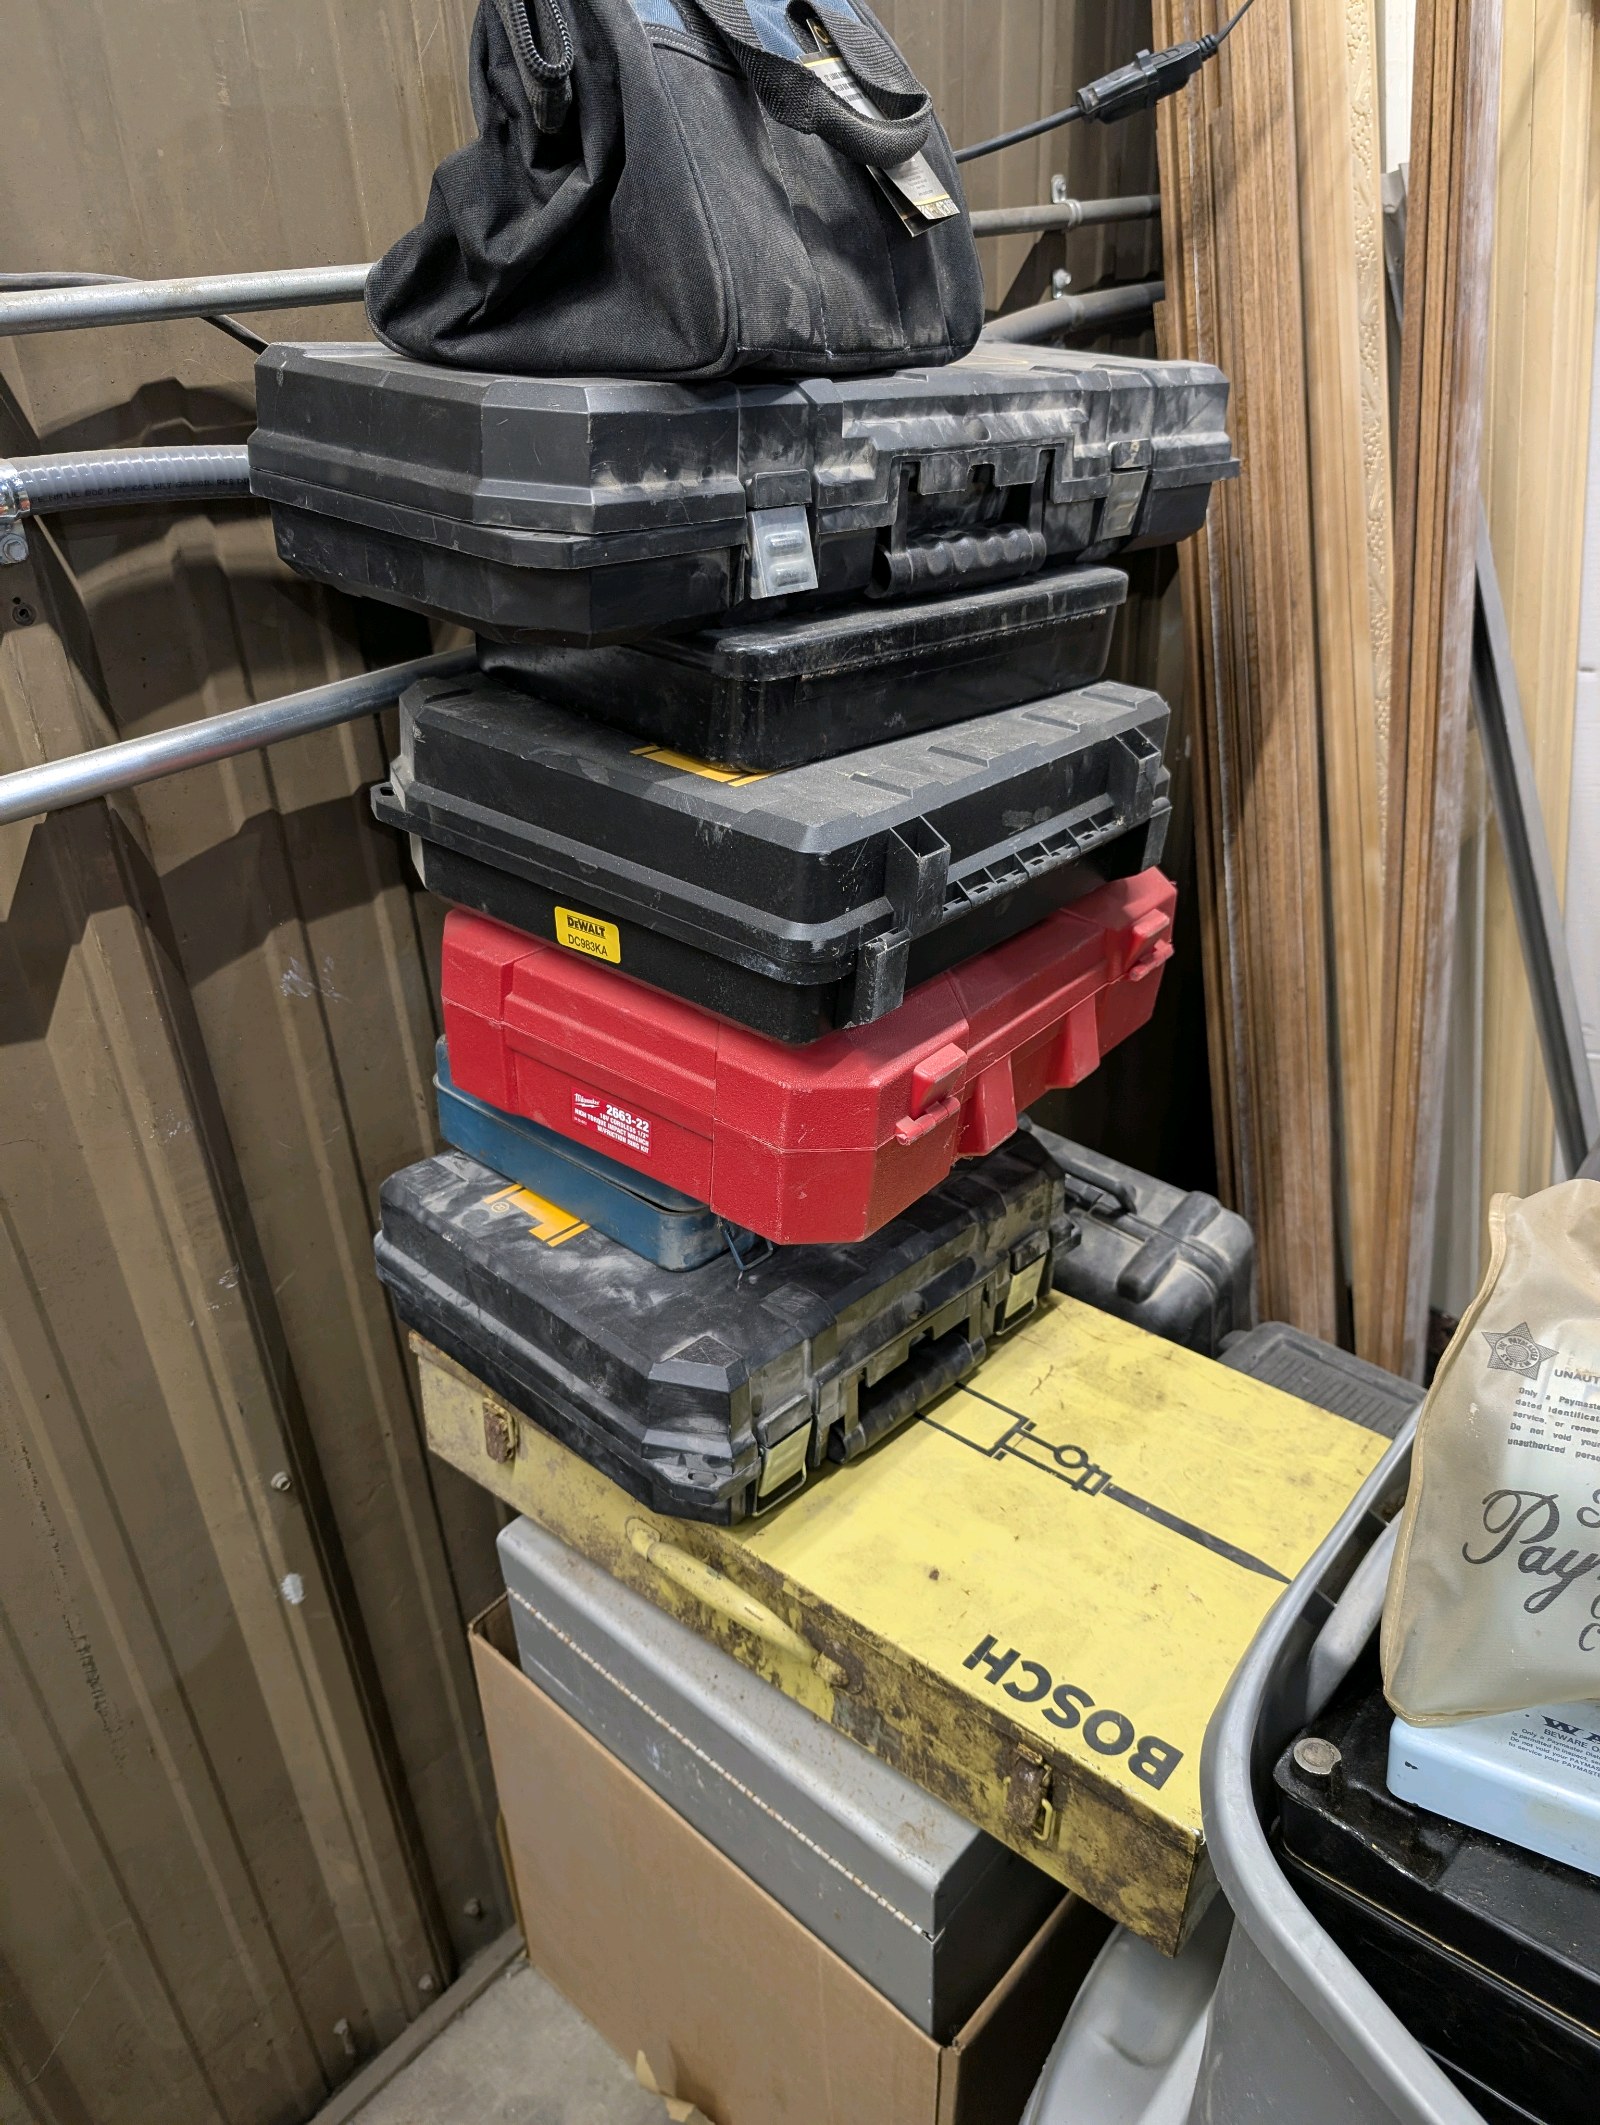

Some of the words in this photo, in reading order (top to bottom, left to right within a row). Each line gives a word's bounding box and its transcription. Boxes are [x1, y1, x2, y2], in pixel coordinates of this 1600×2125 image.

[568, 933, 608, 957] DC983KA
[574, 1107, 587, 1119] HIGH
[587, 1113, 607, 1128] TORQUE
[607, 1122, 627, 1137] IMPACT
[627, 1132, 650, 1148] WRENCH
[606, 1104, 650, 1133] 2663-22
[610, 1117, 637, 1135] CORDLESS
[597, 1124, 627, 1144] W/FRICTION
[627, 1138, 640, 1150] RING
[640, 1145, 650, 1154] KIT
[1518, 1386, 1538, 1399] Only
[1515, 1398, 1542, 1410] dated
[1509, 1422, 1521, 1431] Do
[1529, 1427, 1544, 1436] not
[1553, 1432, 1572, 1442] void
[1554, 1420, 1564, 1428] or
[1570, 1424, 1600, 1435] renew
[1507, 1437, 1566, 1454] unauthorized
[1462, 1489, 1600, 1614] Pay
[962, 1633, 1185, 1791] BOSCH
[1518, 1733, 1552, 1749] permitted
[1553, 1744, 1560, 1752] to
[1521, 1728, 1538, 1738] Only
[1547, 1737, 1584, 1754] Paymaster
[1543, 1728, 1588, 1748] BEWARE
[1517, 1745, 1543, 1758] service
[1544, 1754, 1560, 1763] your
[1535, 1745, 1551, 1754] void
[1552, 1752, 1568, 1761] your
